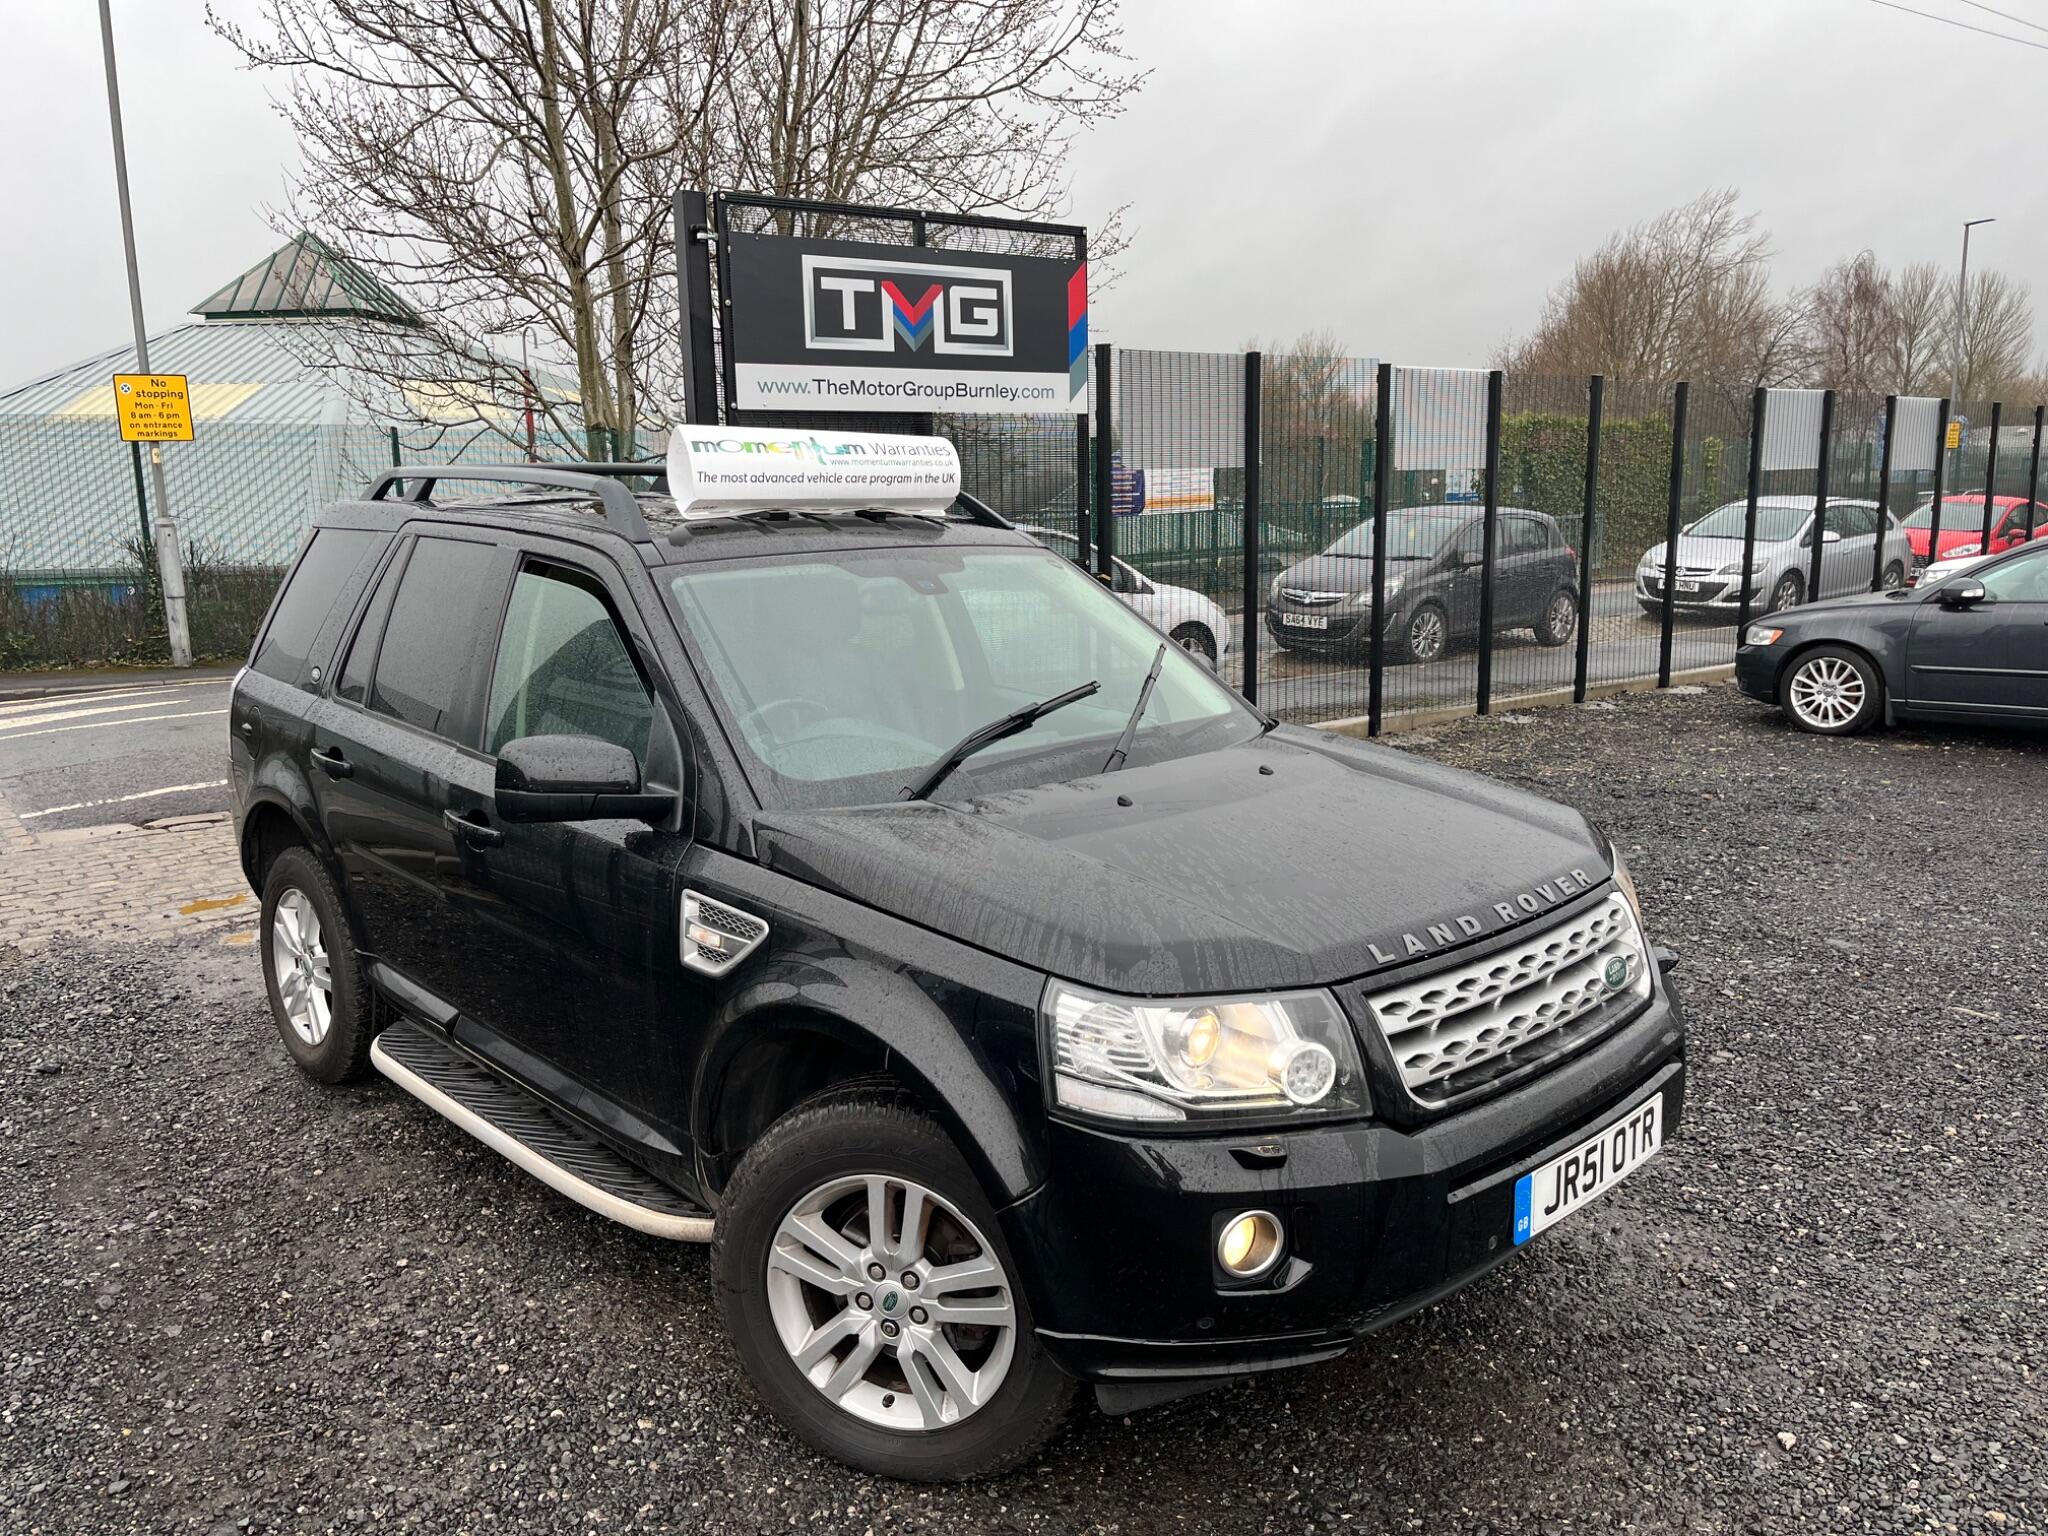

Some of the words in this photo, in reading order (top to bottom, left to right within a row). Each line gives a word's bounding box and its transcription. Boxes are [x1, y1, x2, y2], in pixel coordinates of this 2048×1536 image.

[820, 276, 999, 353] TMG
[150, 379, 167, 388] No
[757, 378, 1055, 402] www.TheMotorGroupBurnley.com
[135, 389, 184, 400] stopping
[134, 401, 154, 409] Mon
[161, 401, 174, 409] Fri
[130, 411, 137, 419] 8
[158, 411, 165, 419] 6
[166, 412, 180, 420] pm
[143, 421, 183, 429] entrance
[136, 430, 178, 438] markings
[691, 437, 867, 466] momentum
[868, 442, 951, 457] Warranties
[829, 458, 954, 467] www.momentumwarranties.co.uk
[697, 470, 718, 484] The
[720, 472, 748, 484] most
[750, 471, 805, 484] advanced
[806, 471, 843, 484] vehicle
[845, 474, 868, 484] care
[869, 474, 912, 486] program
[914, 472, 923, 484] in
[924, 472, 940, 484] the
[942, 472, 955, 484] UK
[1366, 915, 1482, 966] LAND
[1493, 868, 1593, 924] ROVER
[1544, 1139, 1605, 1217] JR51
[1612, 1106, 1655, 1175] OTR
[1517, 1216, 1529, 1233] GB
